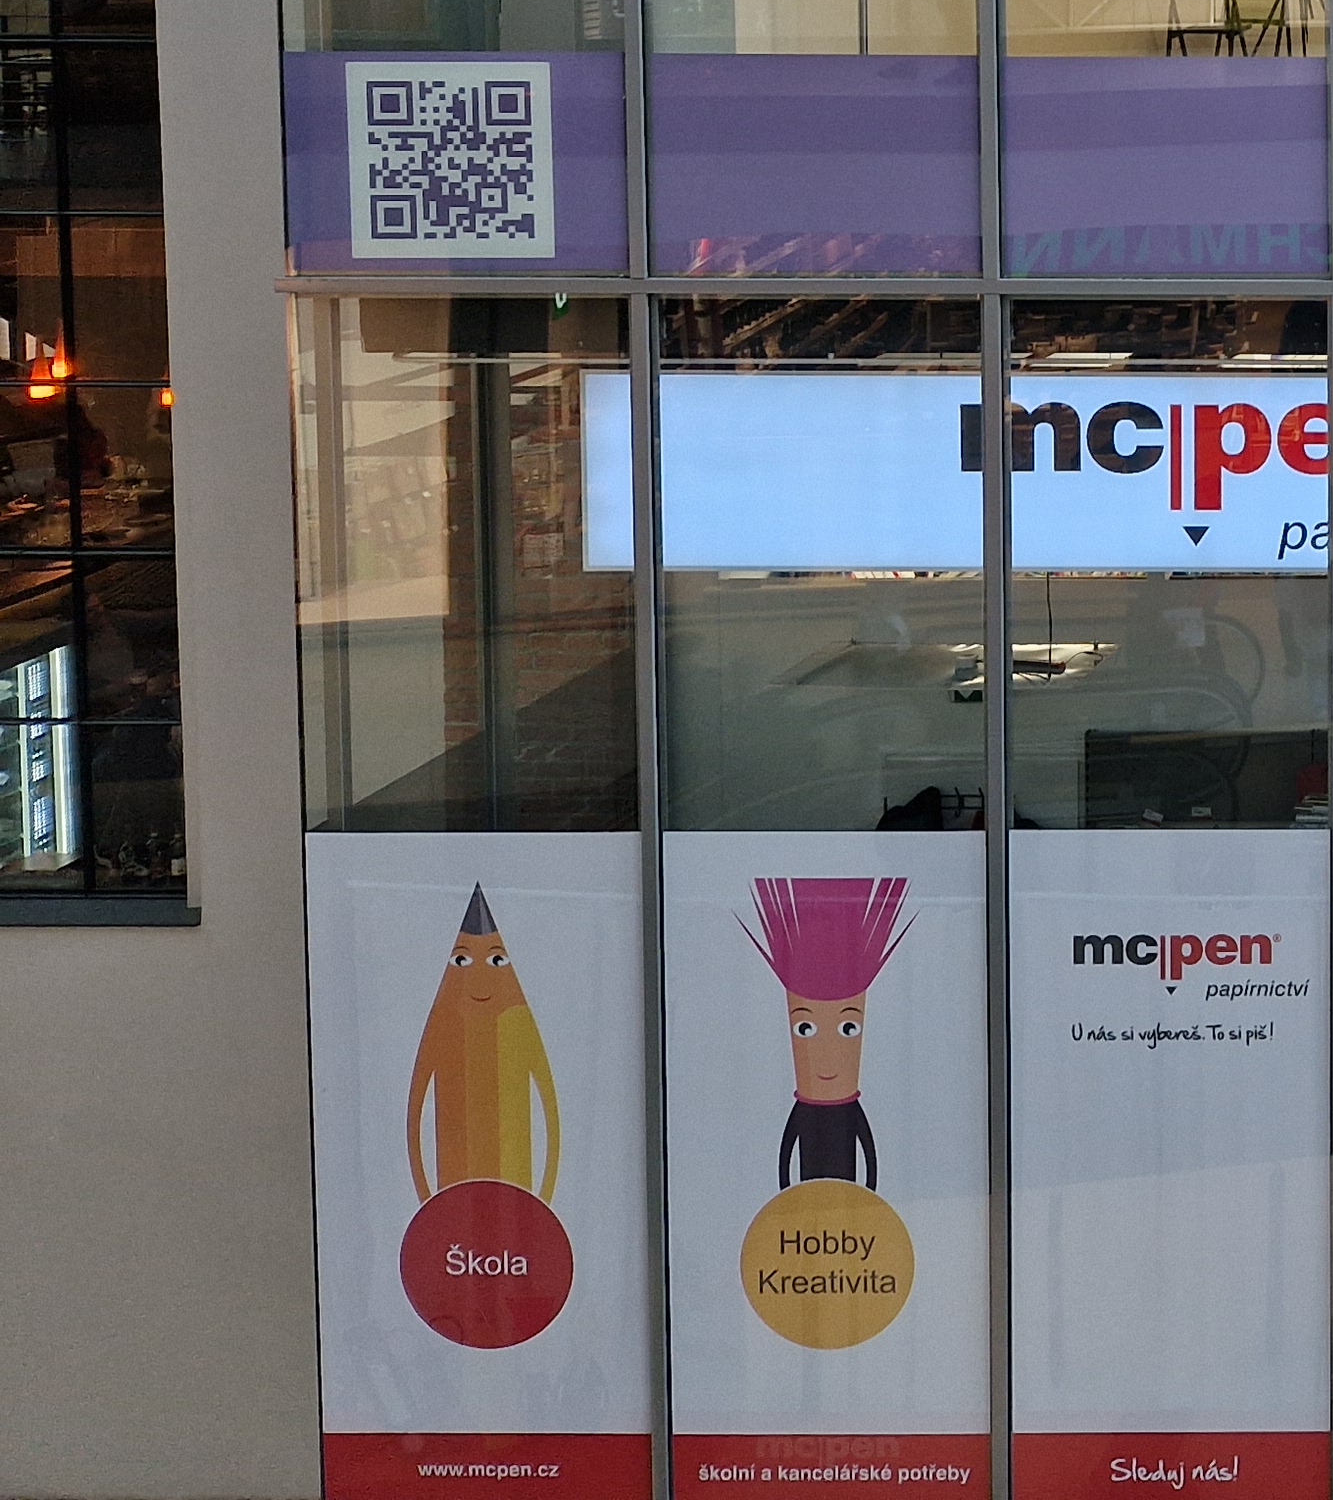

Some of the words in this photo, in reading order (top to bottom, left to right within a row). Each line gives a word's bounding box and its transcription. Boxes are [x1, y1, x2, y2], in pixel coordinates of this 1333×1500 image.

[1205, 978, 1310, 1002] papírnictví
[1071, 1023, 1083, 1041] U
[1087, 1026, 1117, 1041] nás
[1121, 1026, 1134, 1041] si
[1138, 1022, 1205, 1049] vybereš.
[1206, 1024, 1225, 1041] To
[1229, 1025, 1242, 1041] si
[1246, 1021, 1274, 1046] piš!
[779, 1230, 876, 1259] Hobby
[445, 1244, 528, 1276] Škola
[758, 1269, 897, 1295] Kreativita
[418, 1462, 560, 1481] www.mcpen.cz
[698, 1463, 756, 1481] školní
[761, 1467, 771, 1481] a
[778, 1463, 892, 1482] kancelářské
[898, 1464, 971, 1484] potřeby
[1110, 1458, 1186, 1483] Sleduj
[1191, 1456, 1240, 1482] nás!
